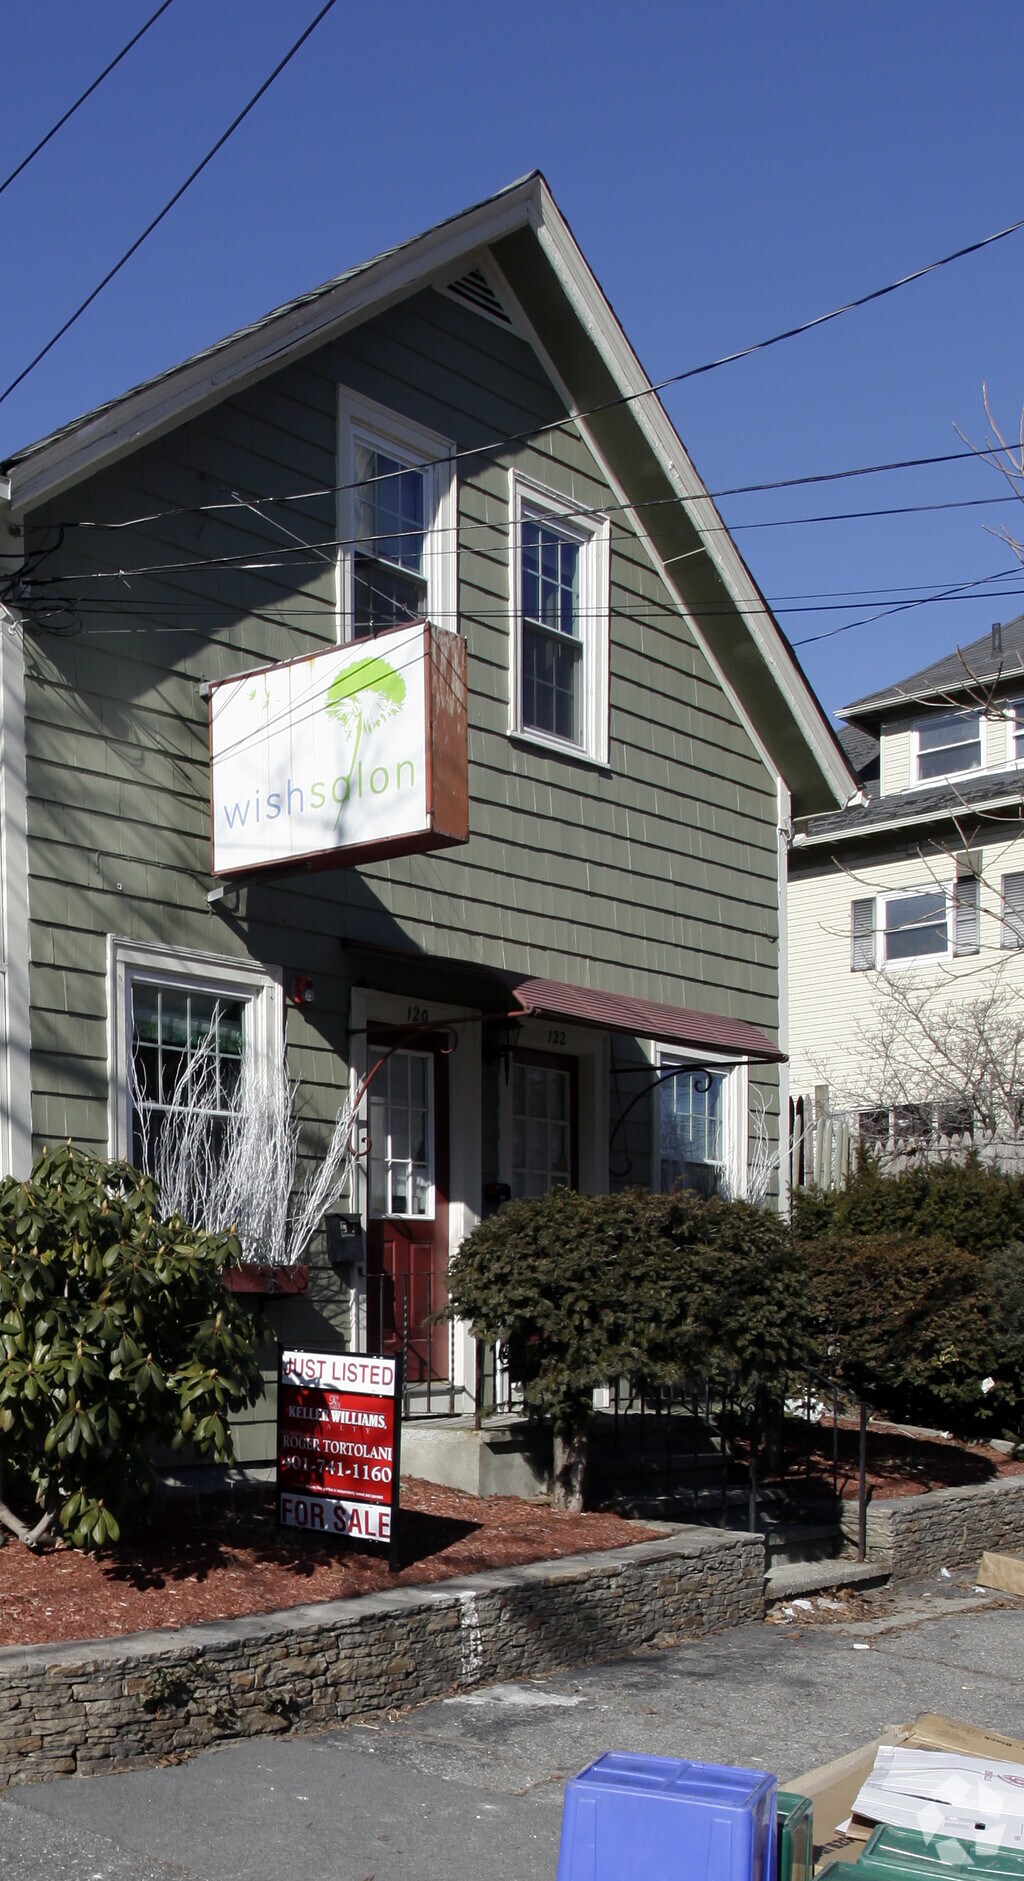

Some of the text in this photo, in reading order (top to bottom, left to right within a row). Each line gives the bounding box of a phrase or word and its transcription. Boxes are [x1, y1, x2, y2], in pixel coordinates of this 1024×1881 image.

[406, 1006, 429, 1023] 120
[548, 1029, 566, 1046] 122
[283, 1357, 394, 1386] JUST LISTED
[288, 1405, 330, 1422] KELLER
[282, 1434, 393, 1462] ROGER TORTOLANI
[281, 1455, 393, 1483] 401-741-1160
[282, 1498, 391, 1539] FOR SALE
